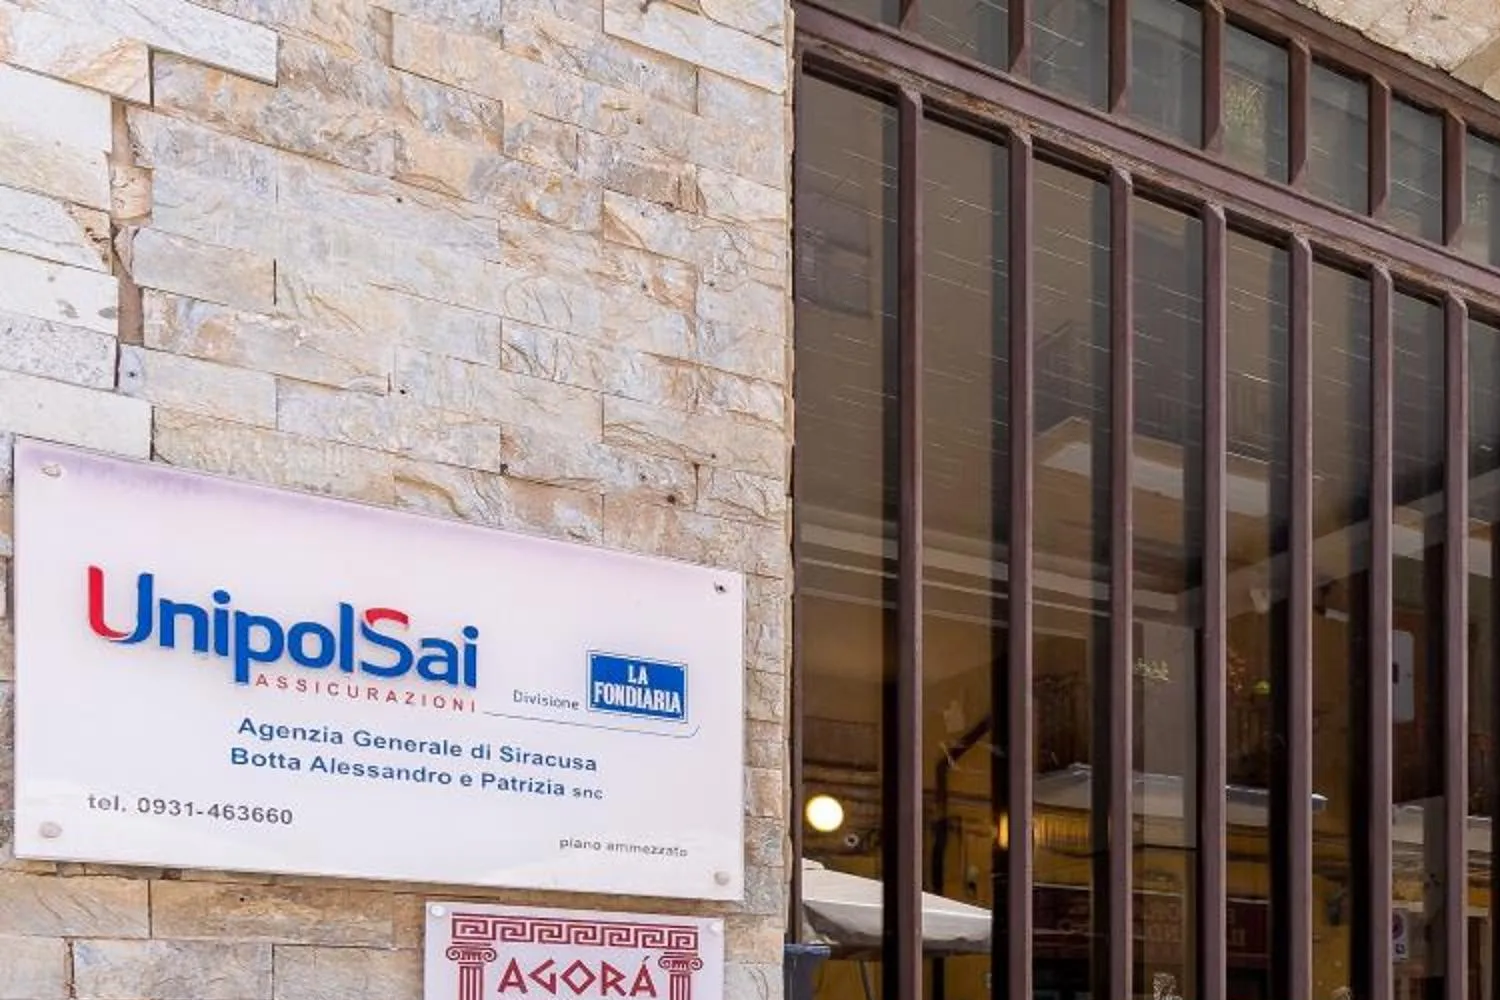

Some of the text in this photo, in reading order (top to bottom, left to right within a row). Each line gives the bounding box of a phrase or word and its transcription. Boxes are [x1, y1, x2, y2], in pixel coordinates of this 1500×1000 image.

[87, 564, 480, 690] UnipolSai
[627, 665, 649, 685] LA
[254, 673, 478, 714] ASSICURAZIONI
[512, 688, 580, 711] Divisione
[593, 681, 683, 713] FONDIARIA
[238, 717, 598, 772] Agenzia Generale di Siracusa
[230, 747, 604, 801] Botta Alessandro e Patrizia snc
[86, 794, 294, 825] tel. 0931-463660
[558, 837, 689, 858] piano ammezzato
